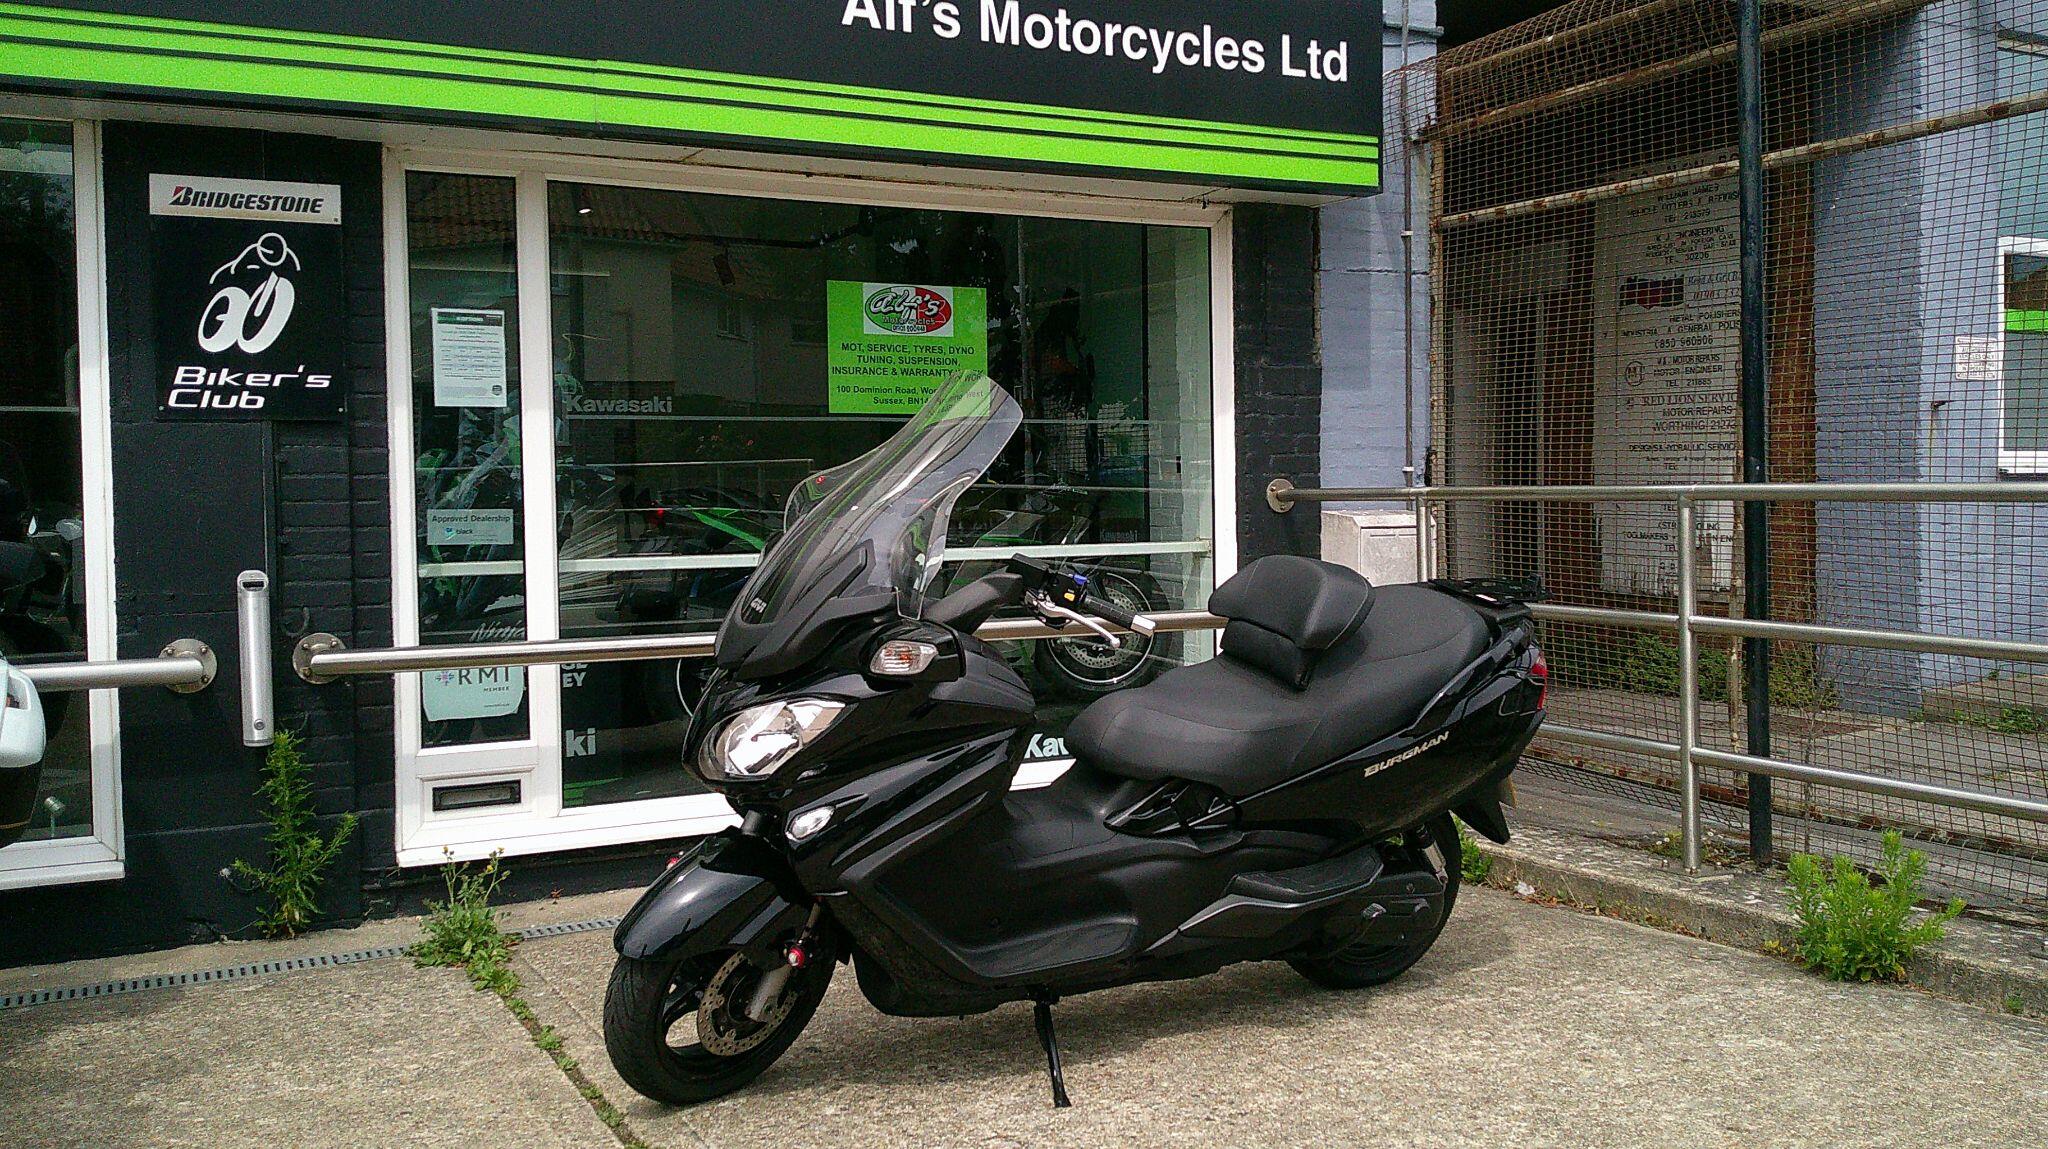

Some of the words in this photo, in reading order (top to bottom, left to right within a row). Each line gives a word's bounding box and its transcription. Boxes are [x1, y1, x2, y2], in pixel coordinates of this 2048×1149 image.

[842, 0, 961, 39] Alf's
[980, 0, 1265, 74] Motorcycles
[1282, 33, 1348, 82] Ltd
[842, 343, 864, 353] MOT,
[867, 343, 910, 354] SERVICE,
[914, 345, 946, 355] TYRES,
[949, 346, 974, 355] DYNO
[857, 355, 895, 364] TUNING,
[898, 356, 961, 366] SUSPENSION,
[832, 366, 888, 376] INSURANCE
[892, 367, 898, 376] &
[900, 368, 953, 377] WARRANTY
[1685, 364, 1723, 375] ENGINEER
[173, 365, 332, 388] Biker's
[1665, 379, 1678, 387] TEL
[837, 385, 850, 393] 100
[854, 386, 892, 394] Dominion
[895, 386, 918, 395] Road,
[168, 389, 265, 409] Club
[566, 395, 672, 412] Kawasaki
[873, 396, 905, 405] Sussex,
[1662, 407, 1693, 417] MOTOR
[1696, 405, 1733, 416] REPAIRS
[1653, 420, 1706, 431] WORTHING
[432, 514, 468, 524] Approved
[471, 514, 511, 523] Dealership
[469, 620, 525, 642] Ninja
[458, 666, 510, 685] RMI
[562, 671, 587, 688] EY
[565, 728, 597, 758] ki
[1364, 731, 1450, 778] BURGMAN
